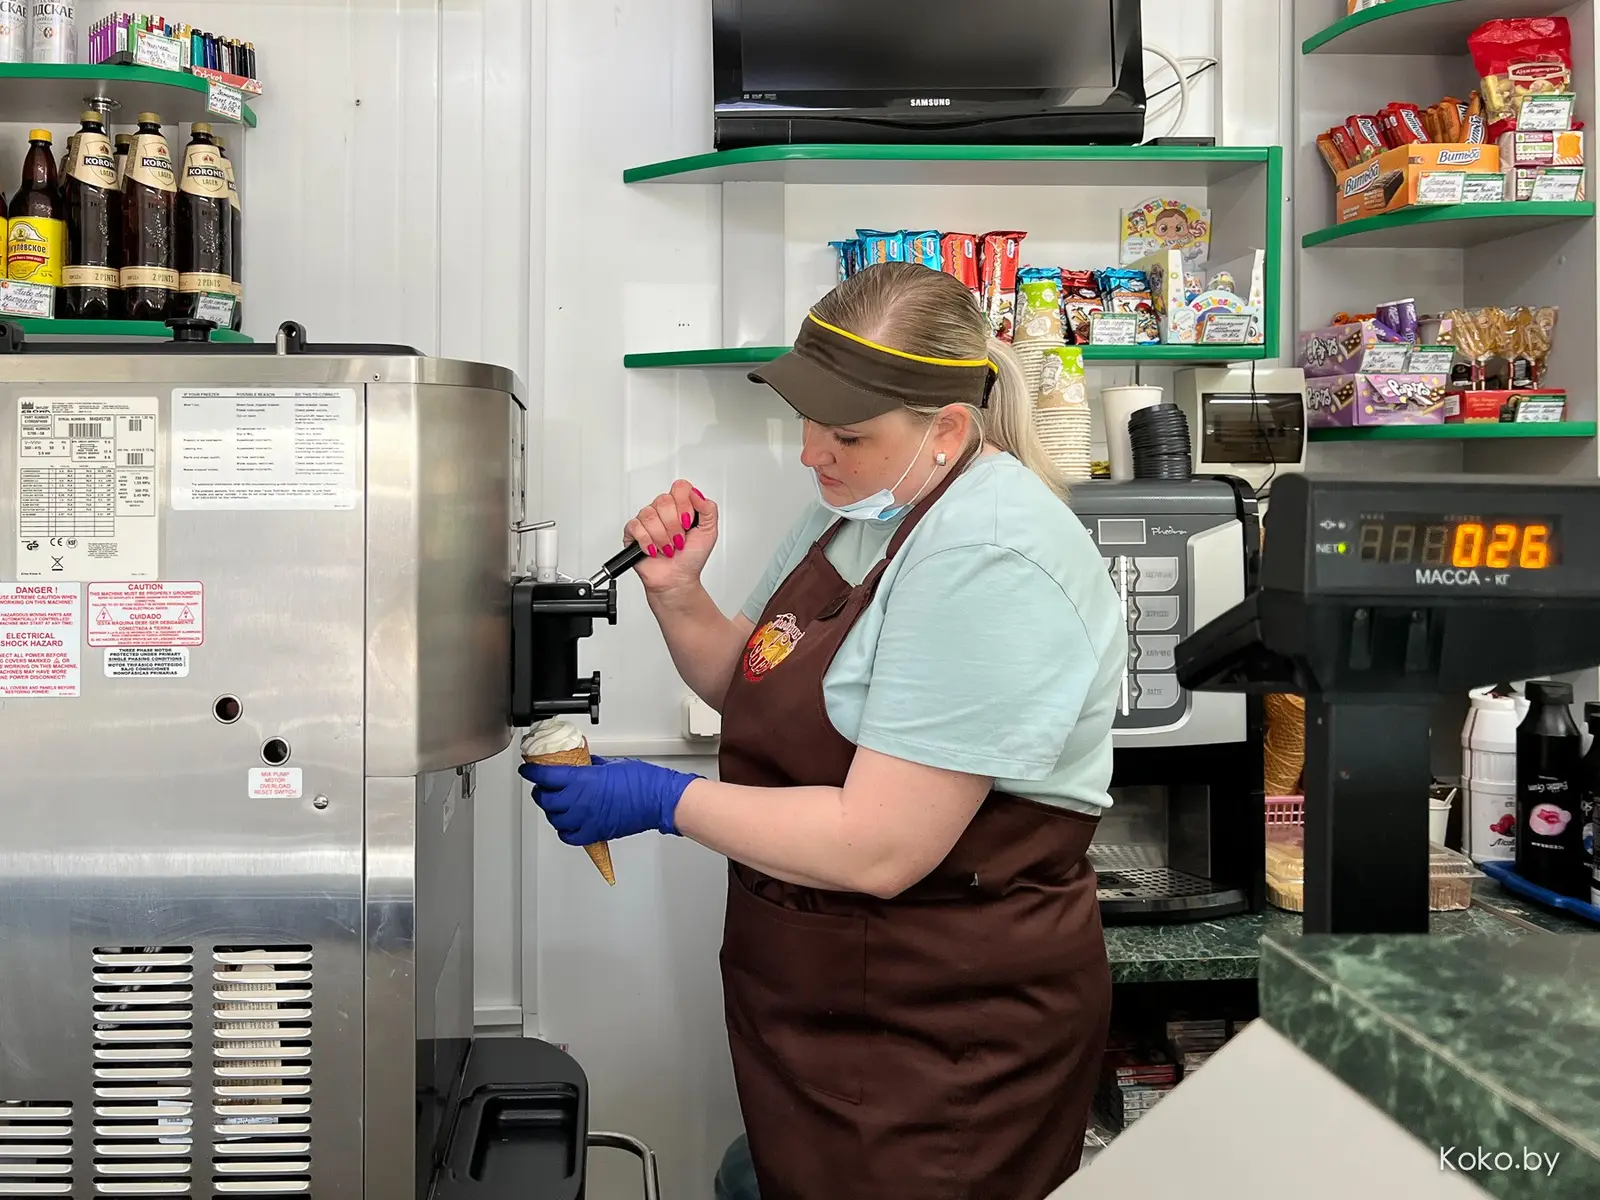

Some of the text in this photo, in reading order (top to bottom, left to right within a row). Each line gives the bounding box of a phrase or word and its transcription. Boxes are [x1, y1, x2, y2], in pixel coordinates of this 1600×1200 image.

[100, 274, 116, 282] PINTS
[158, 274, 174, 283] PINTS
[1387, 379, 1431, 397] Papita
[1307, 387, 1331, 409] Papita
[1151, 526, 1187, 535] Phedra
[50, 538, 62, 546] CE
[1452, 524, 1549, 568] 026
[1416, 570, 1480, 585] МАССА
[1495, 575, 1510, 585] кг
